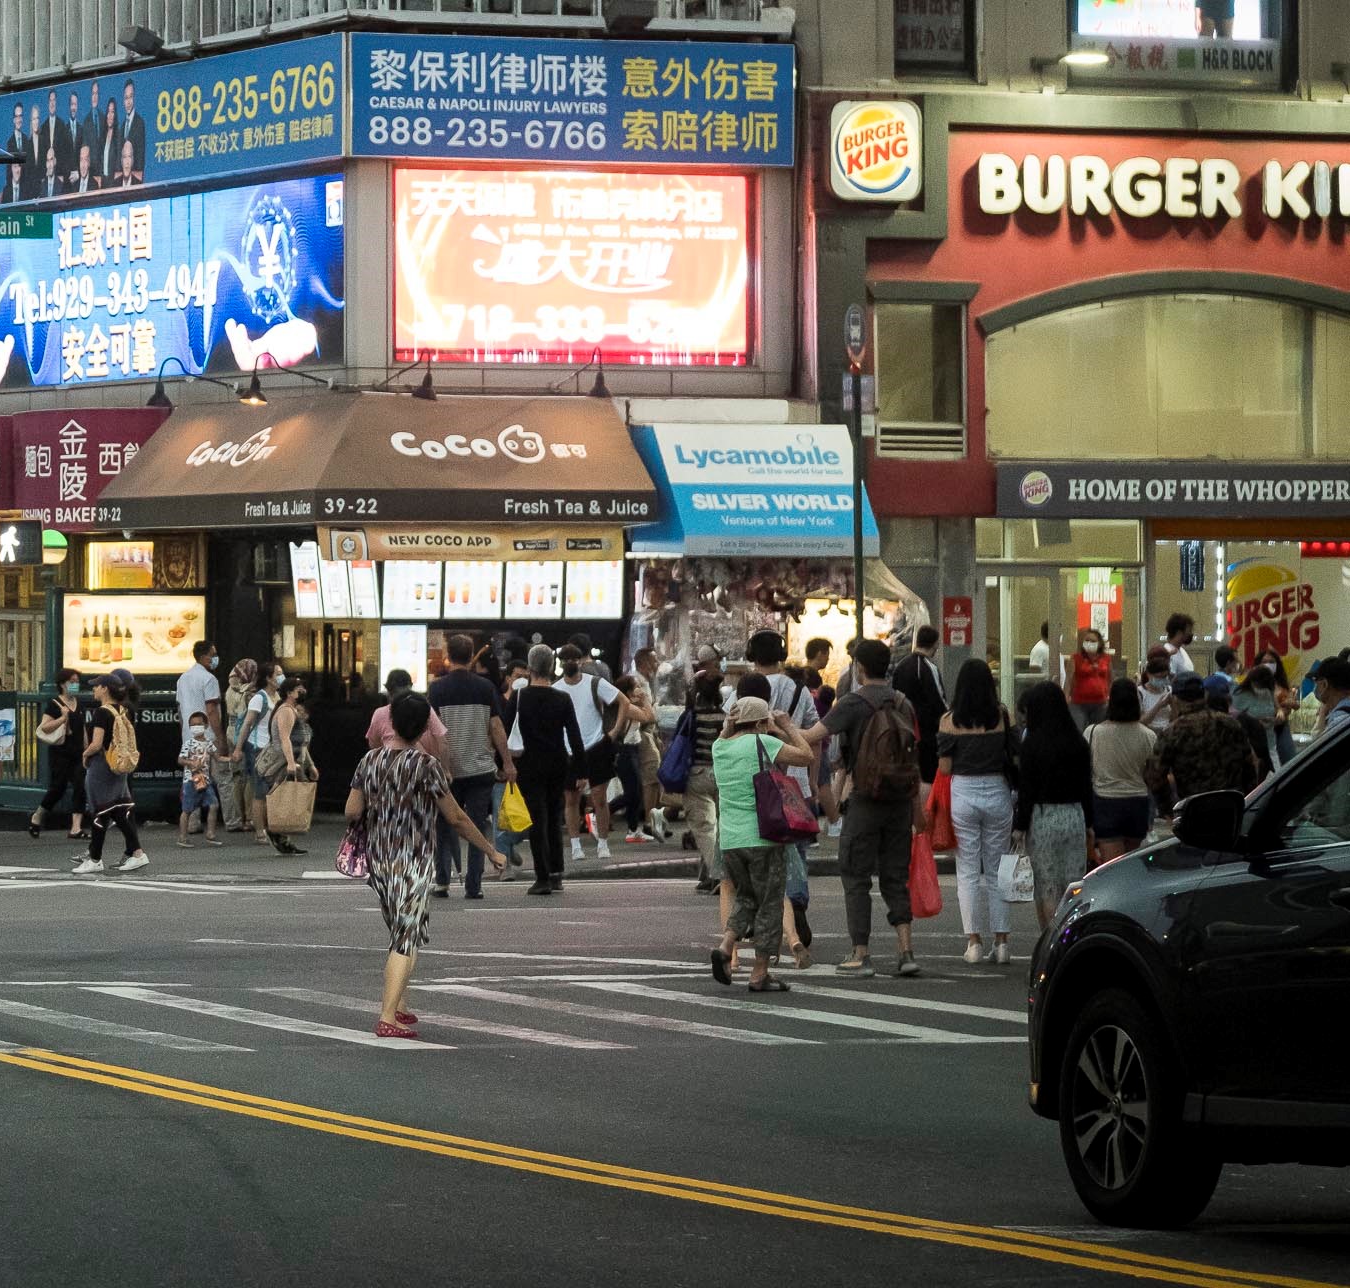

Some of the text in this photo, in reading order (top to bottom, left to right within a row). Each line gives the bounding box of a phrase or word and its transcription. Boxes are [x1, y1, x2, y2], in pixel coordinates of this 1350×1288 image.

[1203, 48, 1274, 71] H&R BLOCK
[370, 49, 607, 97] 黎保利律师楼
[622, 57, 778, 101] 意外伤害
[156, 60, 335, 133] 888-235-6766
[369, 95, 607, 115] CAESAR & NAPOLI INJURY LAWYERS
[368, 115, 607, 151] 888-235-6766
[622, 109, 778, 153] 索赔律师
[843, 120, 906, 154] BURGER
[846, 136, 909, 175] KING
[978, 153, 1242, 218] BURGER
[26, 215, 34, 227] St
[58, 203, 153, 270] 汇款中国
[10, 259, 222, 325] Tel:929-343-4947
[62, 318, 156, 382] 安全可靠
[391, 431, 496, 460] CoCo
[674, 444, 839, 468] Lycamobile
[58, 419, 87, 501] 金陵
[784, 467, 809, 475] world
[1024, 485, 1050, 497] KING
[1068, 479, 1140, 501] HOME
[1145, 479, 1177, 501] OF
[1181, 480, 1229, 501] THE
[245, 500, 311, 517] Fresh Tea & Juice
[324, 498, 378, 514] 39-22
[504, 498, 648, 516] Fresh Tea & Juice
[692, 493, 855, 512] SILVER WORLD
[99, 507, 122, 522] 39-22
[721, 515, 835, 526] Venture of New York
[388, 535, 492, 547] NEW COCO APP
[1089, 567, 1110, 583] NOW
[1083, 583, 1117, 604] HIRING
